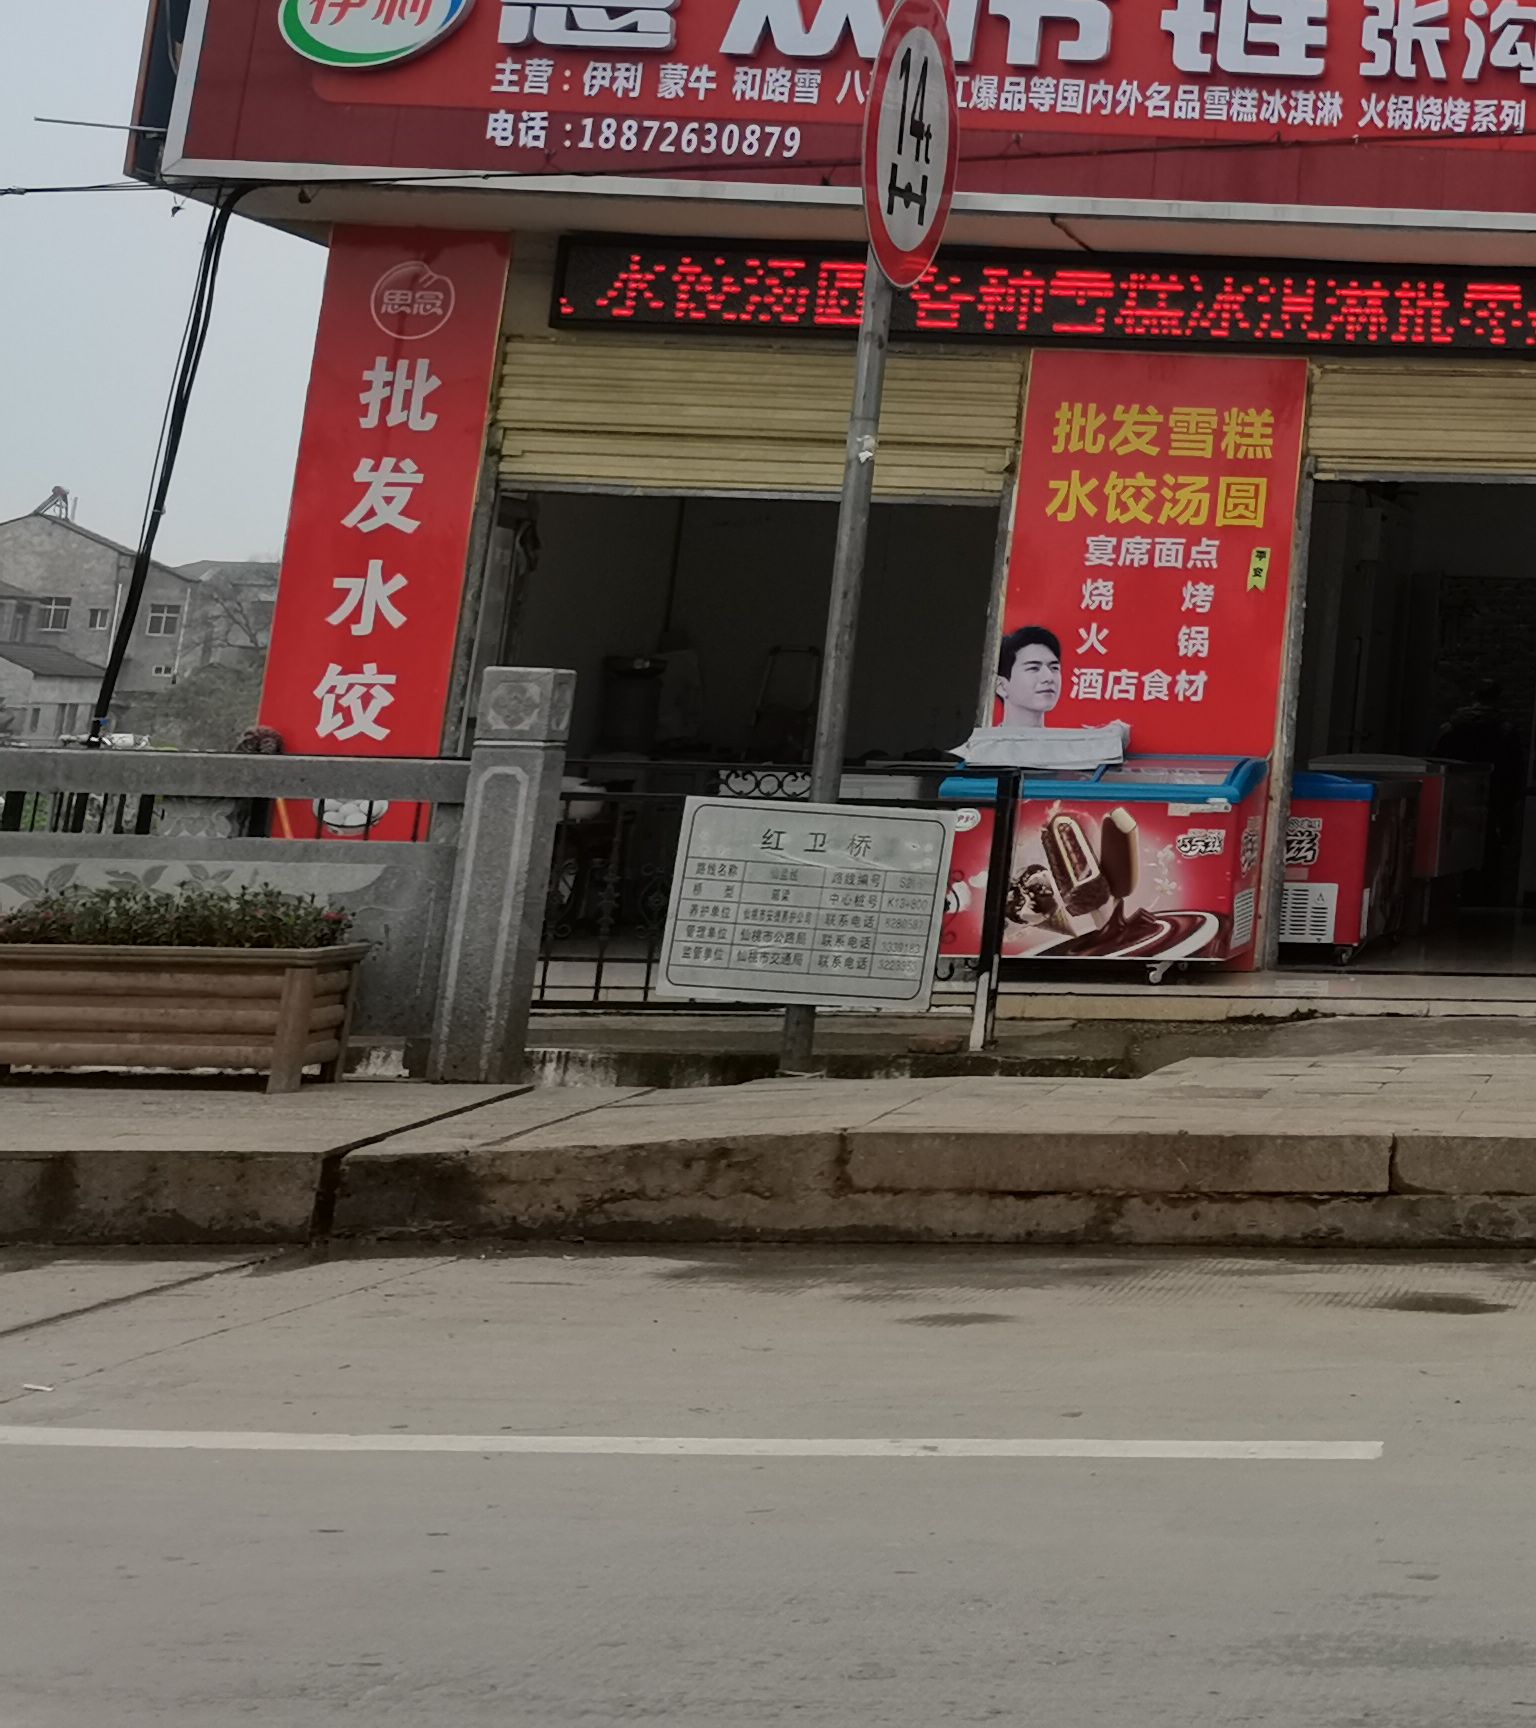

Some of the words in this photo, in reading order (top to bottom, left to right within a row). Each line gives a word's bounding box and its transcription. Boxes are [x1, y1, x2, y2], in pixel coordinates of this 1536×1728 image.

[657, 63, 717, 101] 蒙牛
[732, 66, 822, 106] 和路雪
[1358, 92, 1526, 136] 火锅烧烤系列
[1051, 402, 1275, 460] 批发雪糕
[1045, 470, 1268, 528] 水饺汤圆
[312, 355, 443, 742] 批发水饺
[1084, 535, 1221, 570] 宴席面点
[1070, 667, 1208, 703] 酒店食材
[761, 828, 872, 858] 红卫桥
